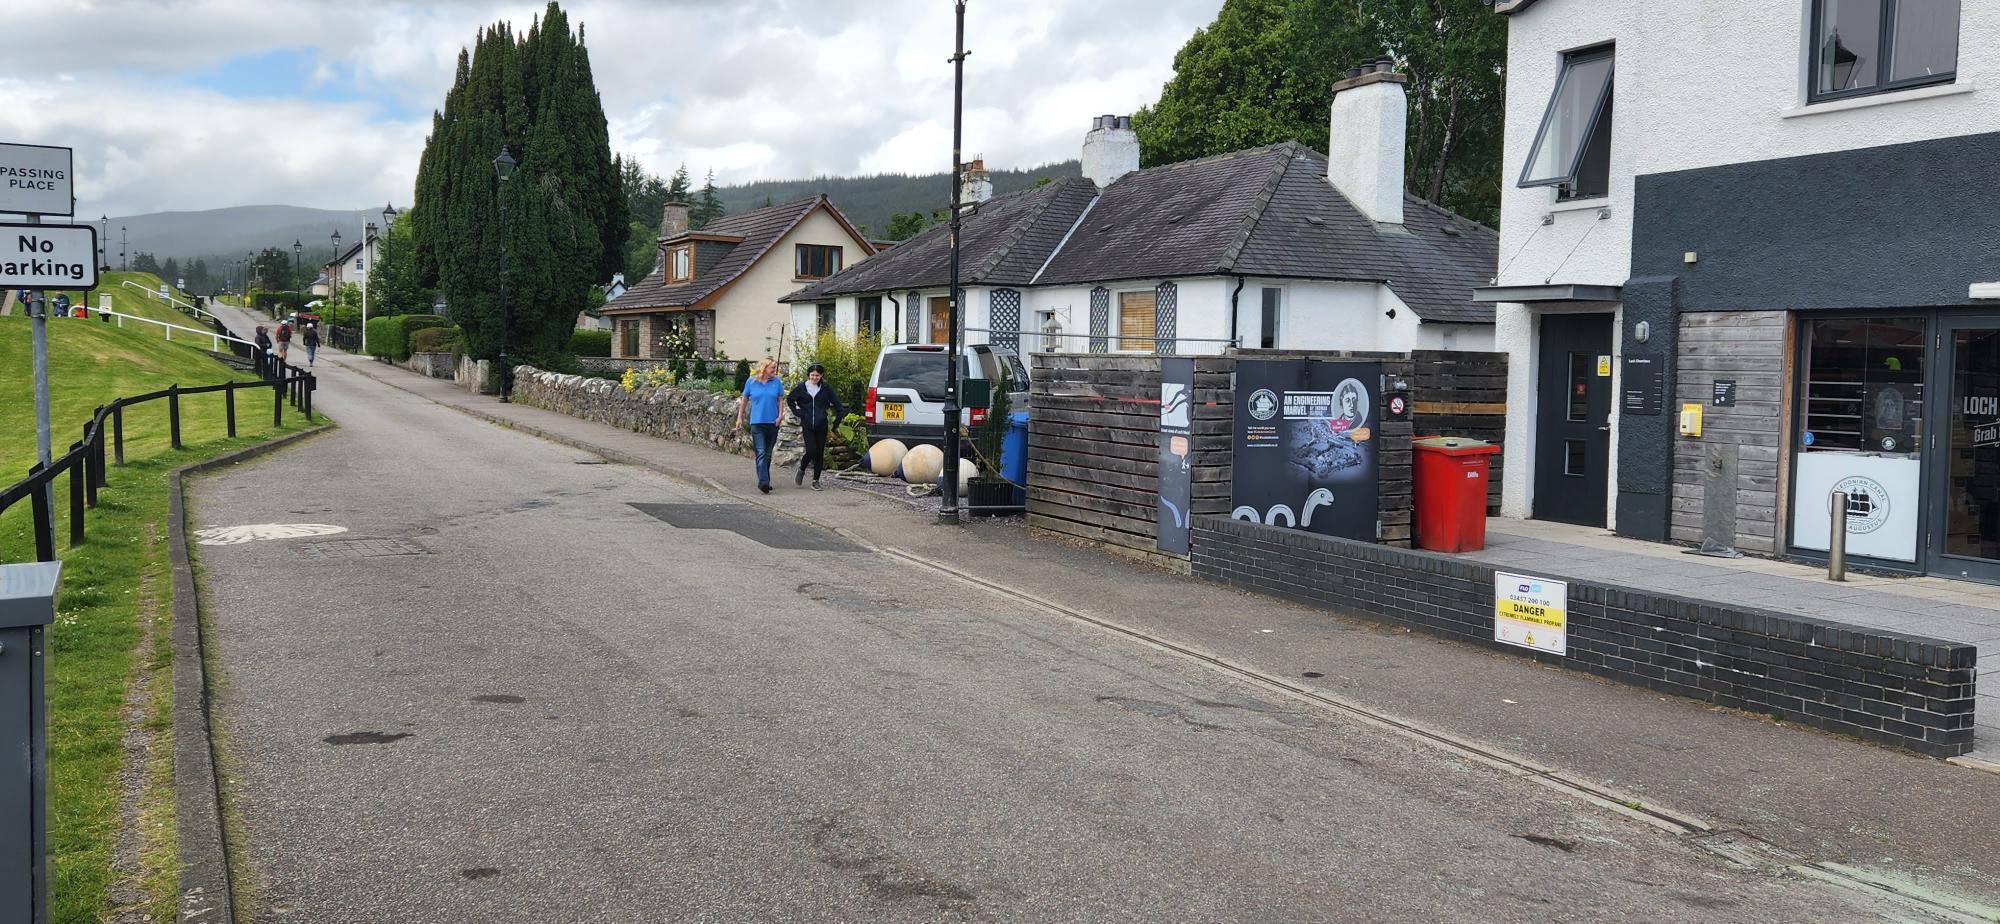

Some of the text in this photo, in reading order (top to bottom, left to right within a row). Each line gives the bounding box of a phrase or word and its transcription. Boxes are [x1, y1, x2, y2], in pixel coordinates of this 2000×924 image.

[0, 167, 65, 179] PASSING
[9, 179, 55, 191] PLACE
[18, 235, 54, 253] No
[0, 259, 84, 280] arking
[1284, 395, 1292, 405] AN
[1293, 395, 1331, 406] ENGINEERING
[1963, 396, 1998, 415] LOCH
[886, 411, 900, 419] RRA
[1284, 406, 1307, 415] MARVEL
[1974, 426, 1996, 442] Grab
[1513, 604, 1545, 616] DANGER
